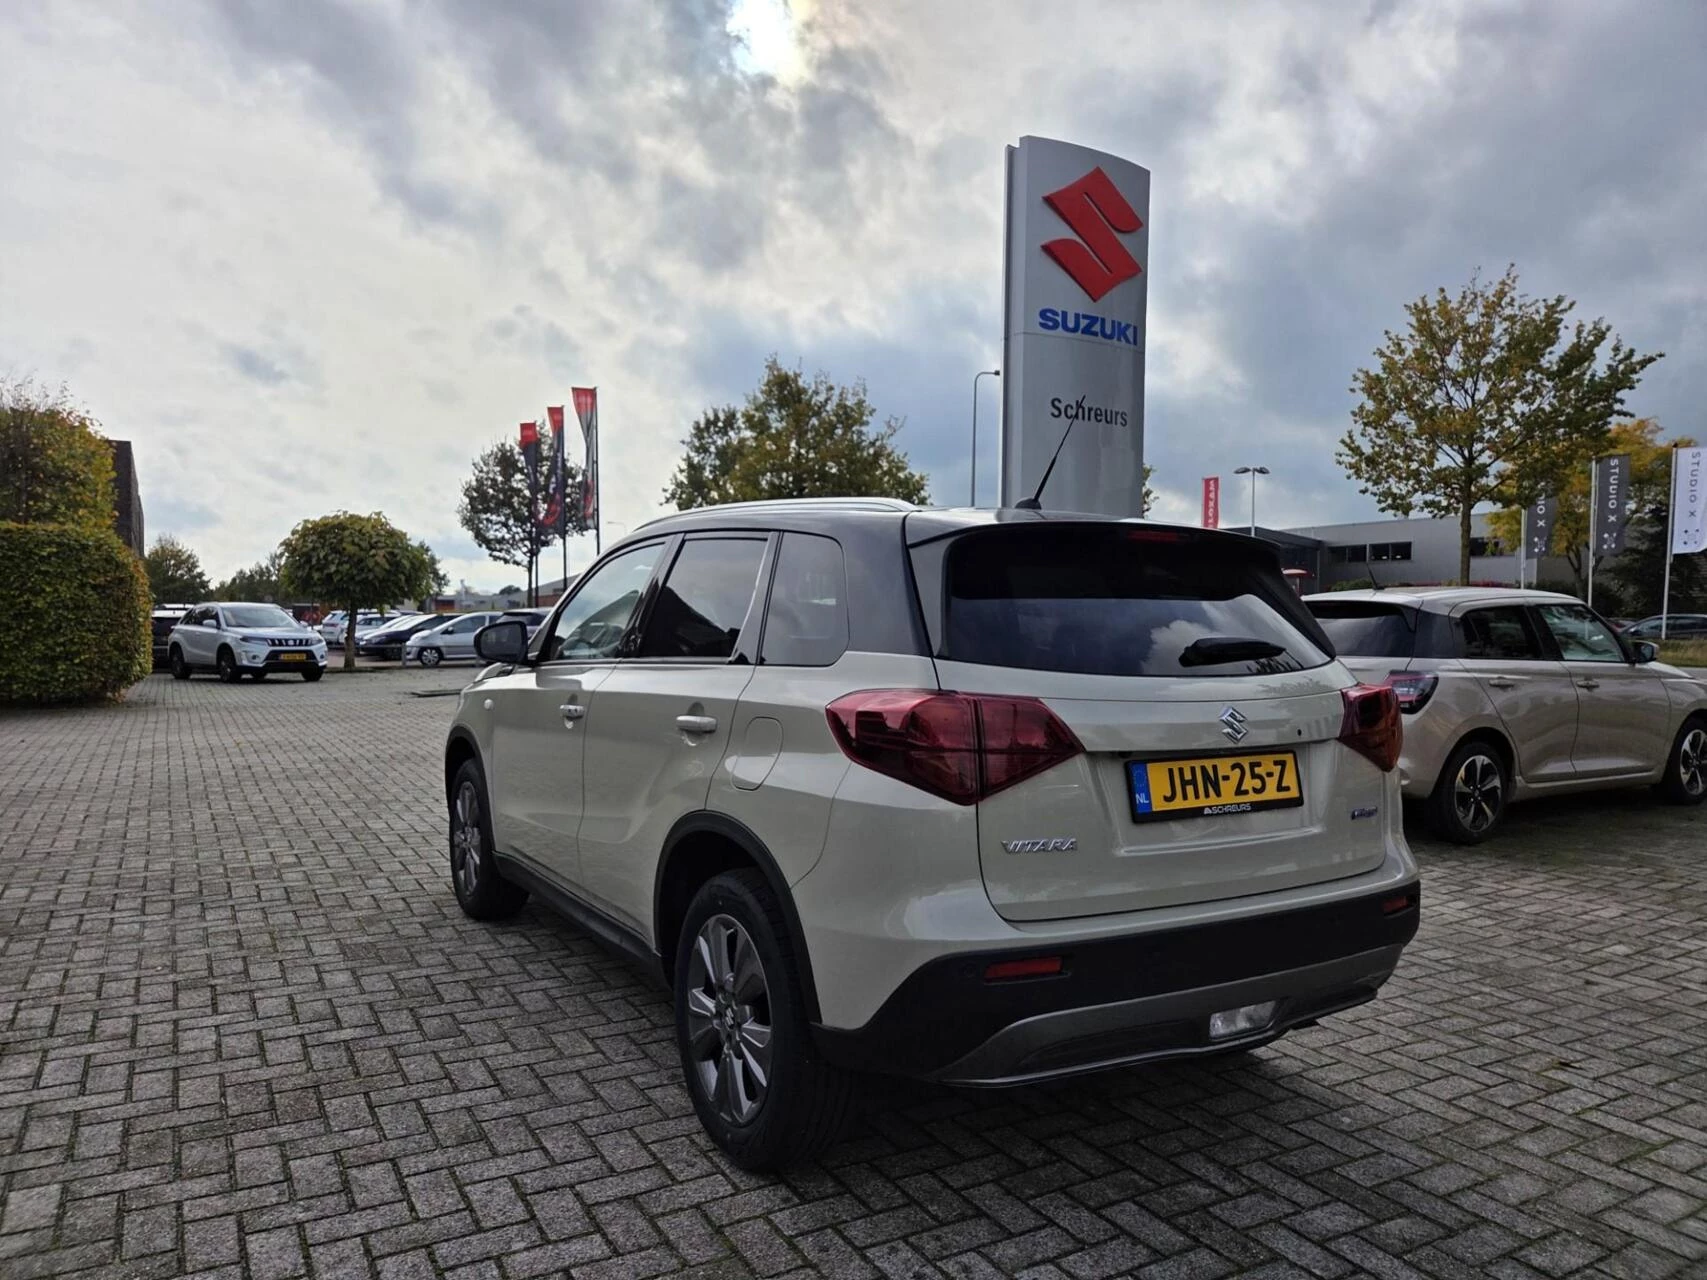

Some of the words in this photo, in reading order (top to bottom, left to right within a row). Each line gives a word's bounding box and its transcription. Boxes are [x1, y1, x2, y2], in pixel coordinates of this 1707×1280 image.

[1039, 308, 1138, 346] SUZUKI
[1050, 397, 1128, 427] Schreurs
[1608, 458, 1619, 509] STUDIO
[1689, 452, 1701, 503] STUDIO
[1537, 519, 1546, 527] X
[1608, 514, 1617, 522] X
[1689, 510, 1697, 518] X
[1163, 760, 1291, 803] JHN-25-Z
[1135, 793, 1149, 805] NL
[1001, 838, 1077, 853] VITARA
